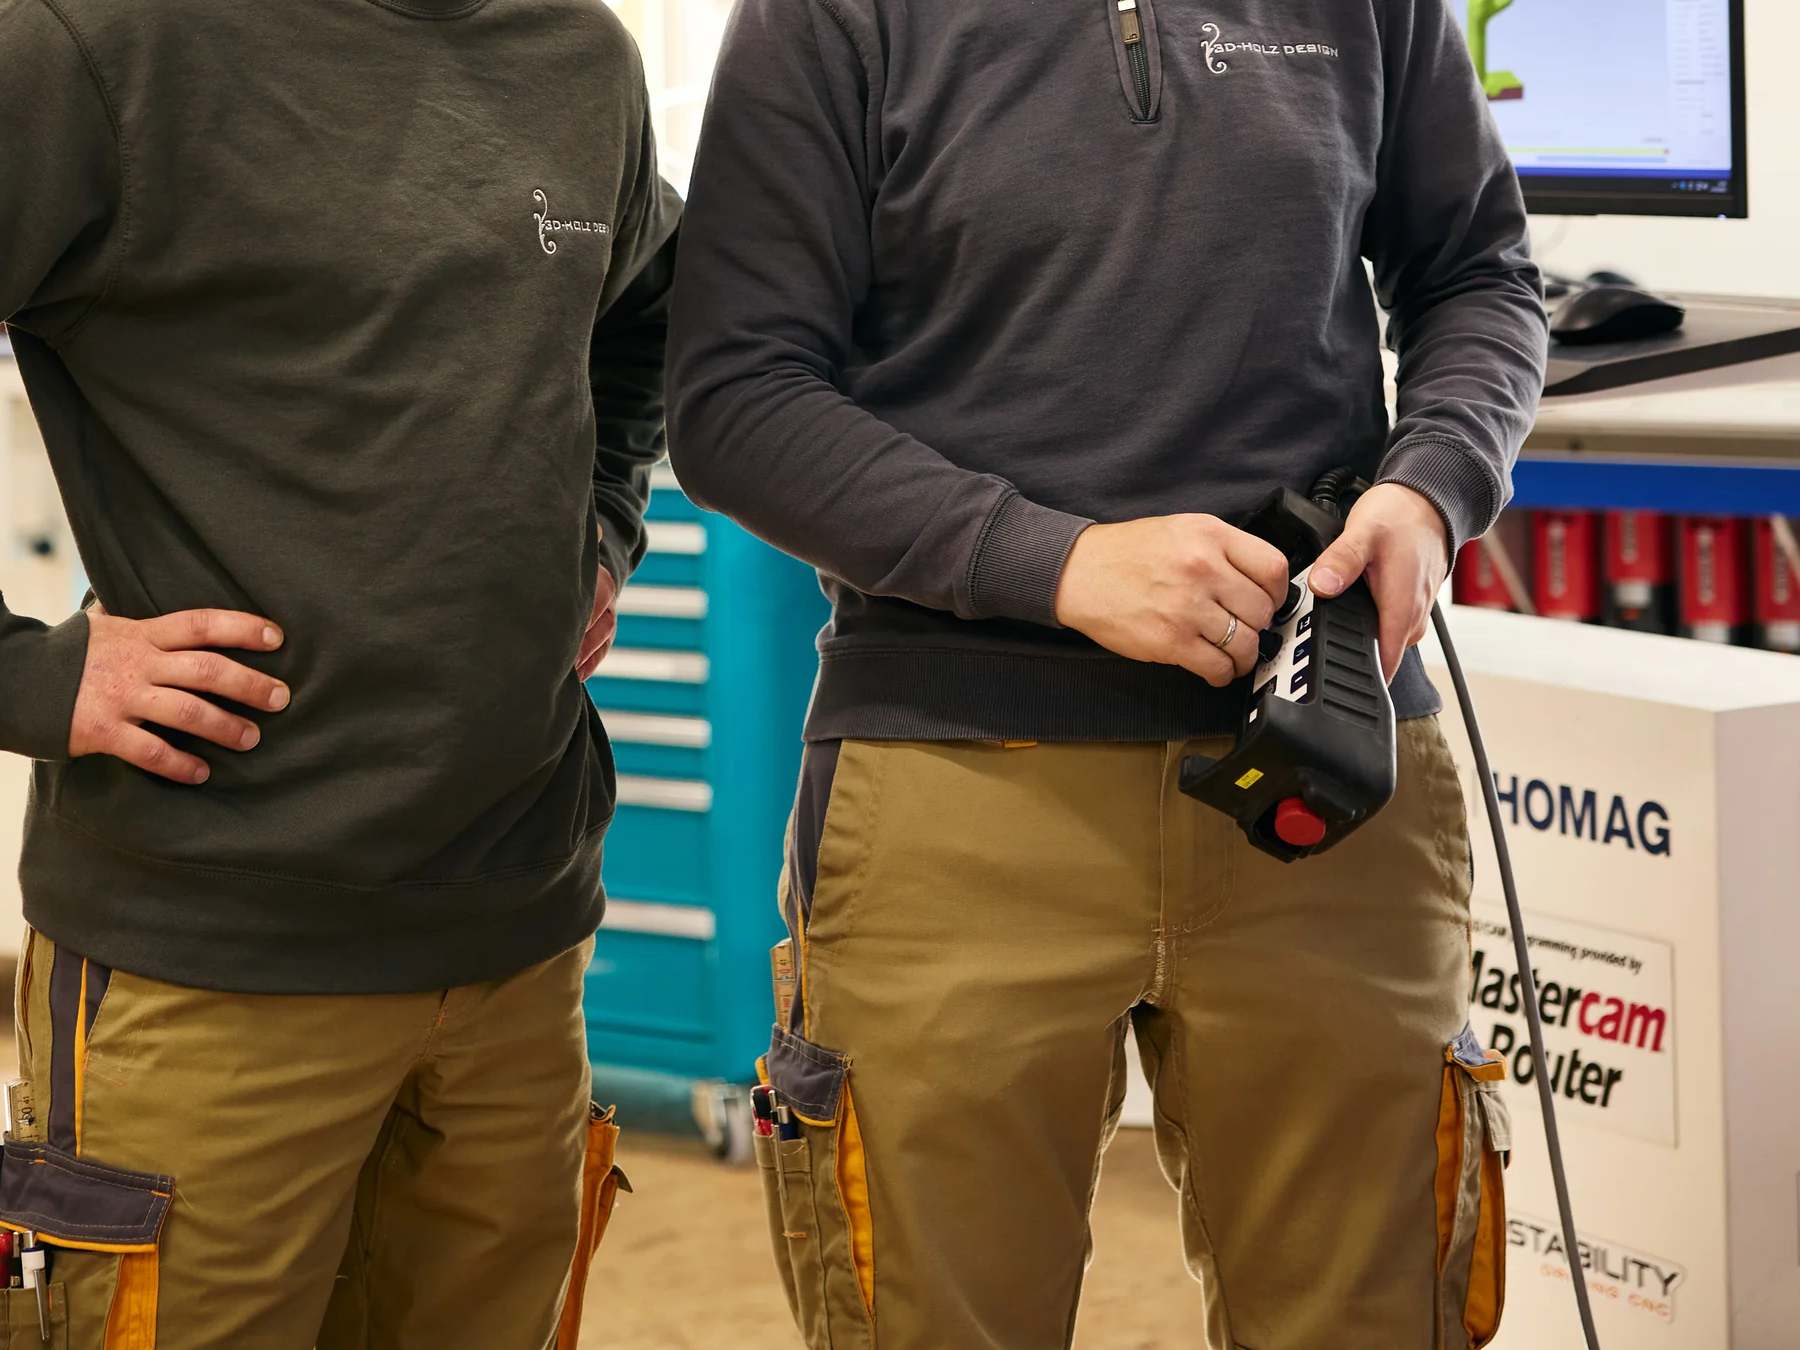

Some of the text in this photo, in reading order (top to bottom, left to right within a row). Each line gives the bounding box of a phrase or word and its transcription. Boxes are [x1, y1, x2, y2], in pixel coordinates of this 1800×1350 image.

[1213, 42, 1339, 57] 3D-HOLZ DESIGN
[544, 219, 591, 231] 3D-HOLZ
[1493, 772, 1671, 857] HOMAG
[1512, 934, 1577, 959] gramming
[1629, 957, 1643, 975] by
[1491, 1023, 1623, 1107] Router
[1507, 1219, 1679, 1297] STABILITY
